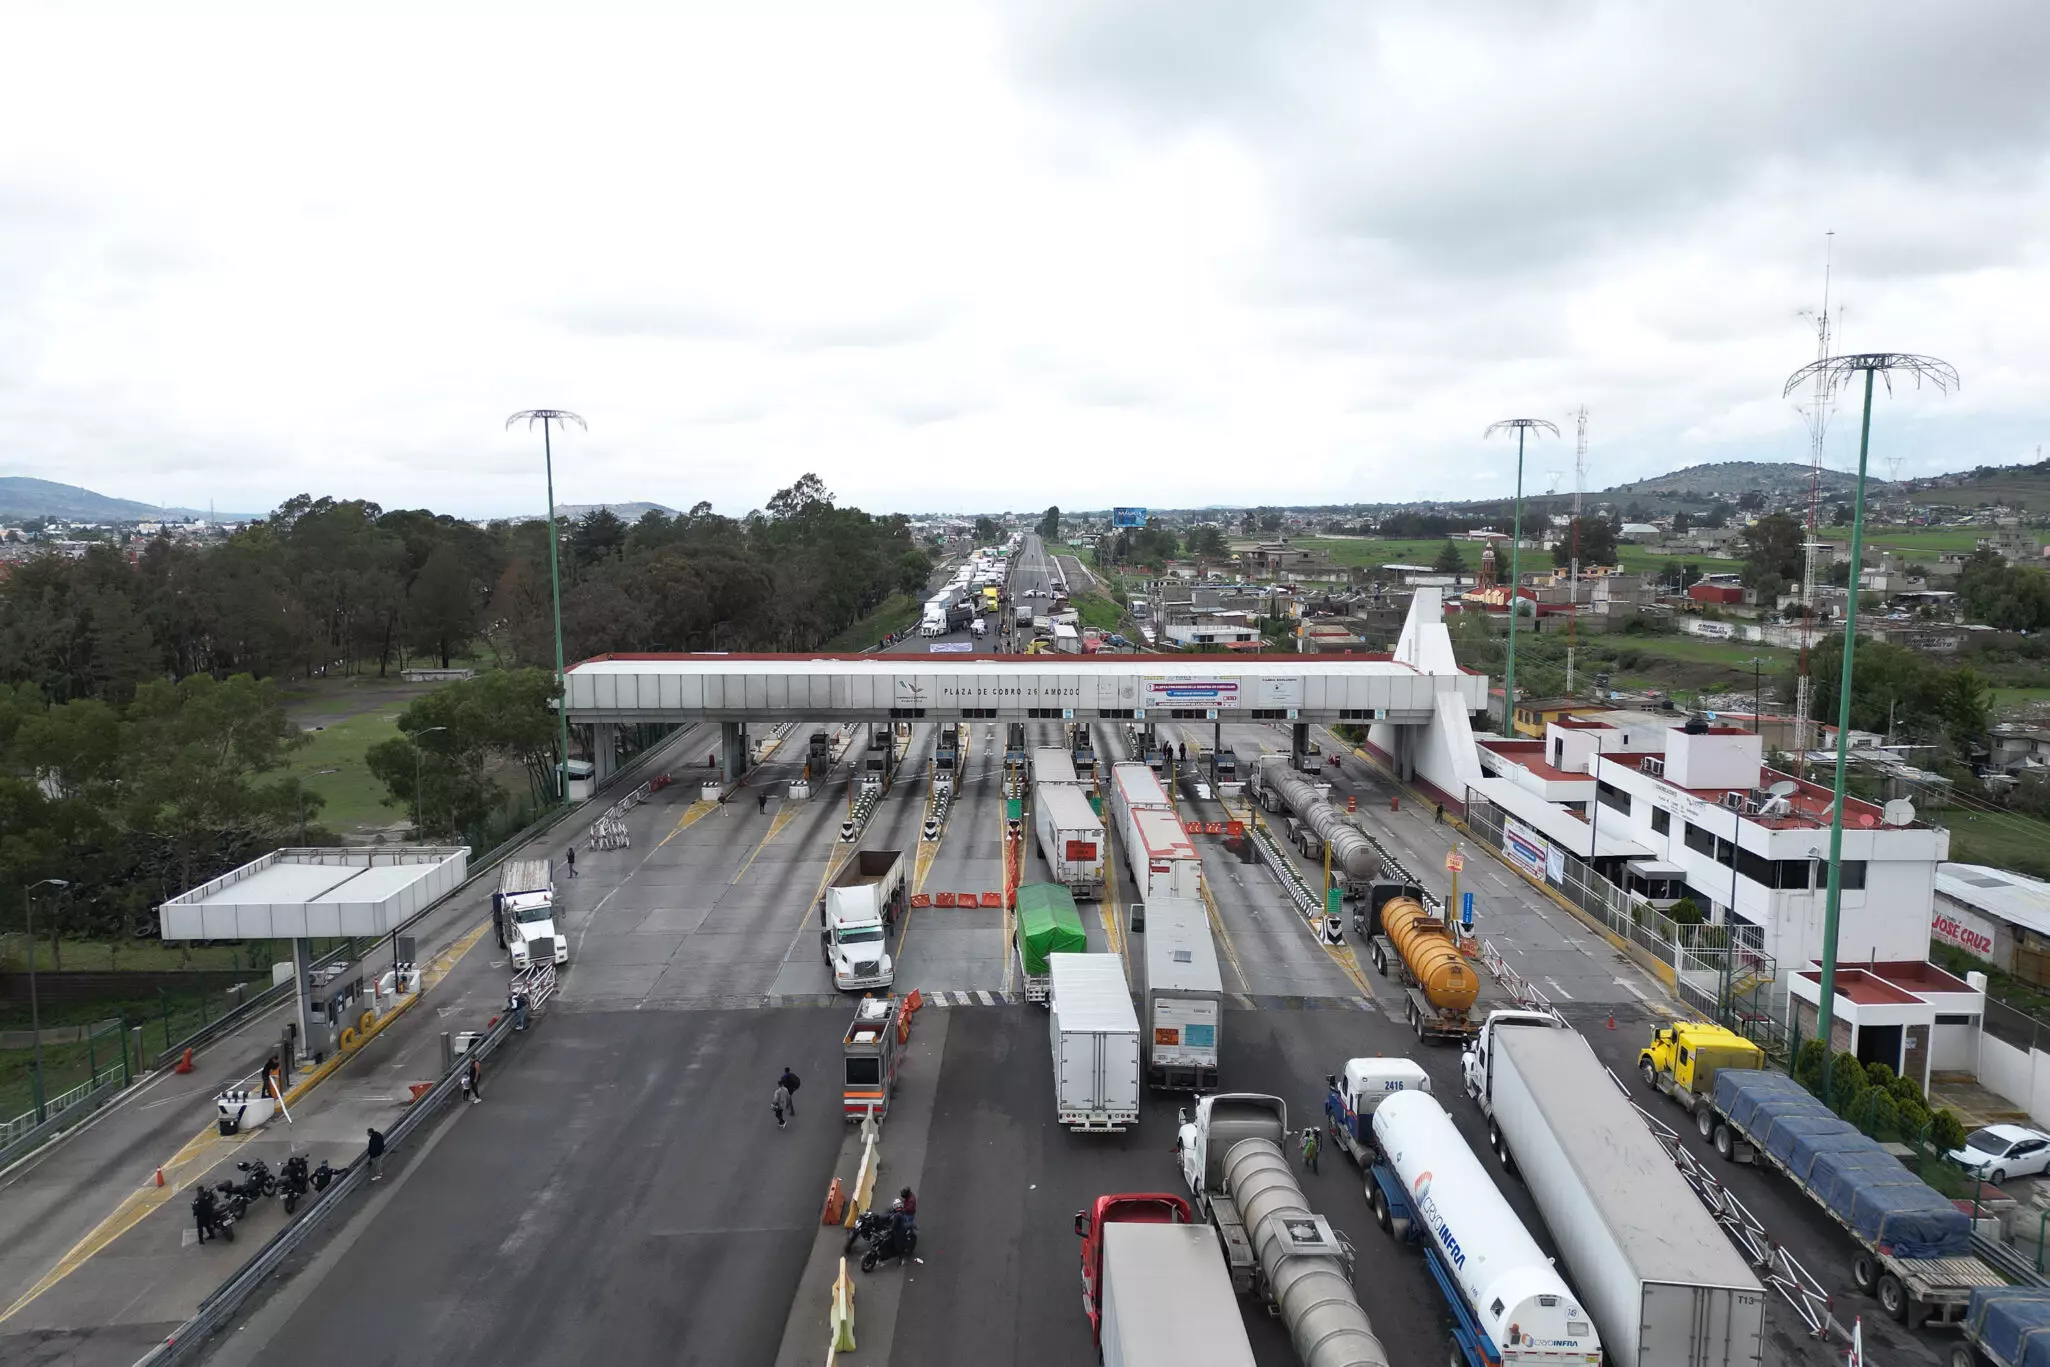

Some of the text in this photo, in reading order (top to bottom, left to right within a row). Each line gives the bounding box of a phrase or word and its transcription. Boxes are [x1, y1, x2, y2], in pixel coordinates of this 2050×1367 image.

[944, 688, 1080, 696] PLAZA DE COBRO 26 AMOZOC
[1932, 914, 1962, 939] JOSÉ
[1960, 928, 1991, 953] CRUZ
[1385, 1080, 1403, 1091] 2416
[1738, 1295, 1754, 1305] T13
